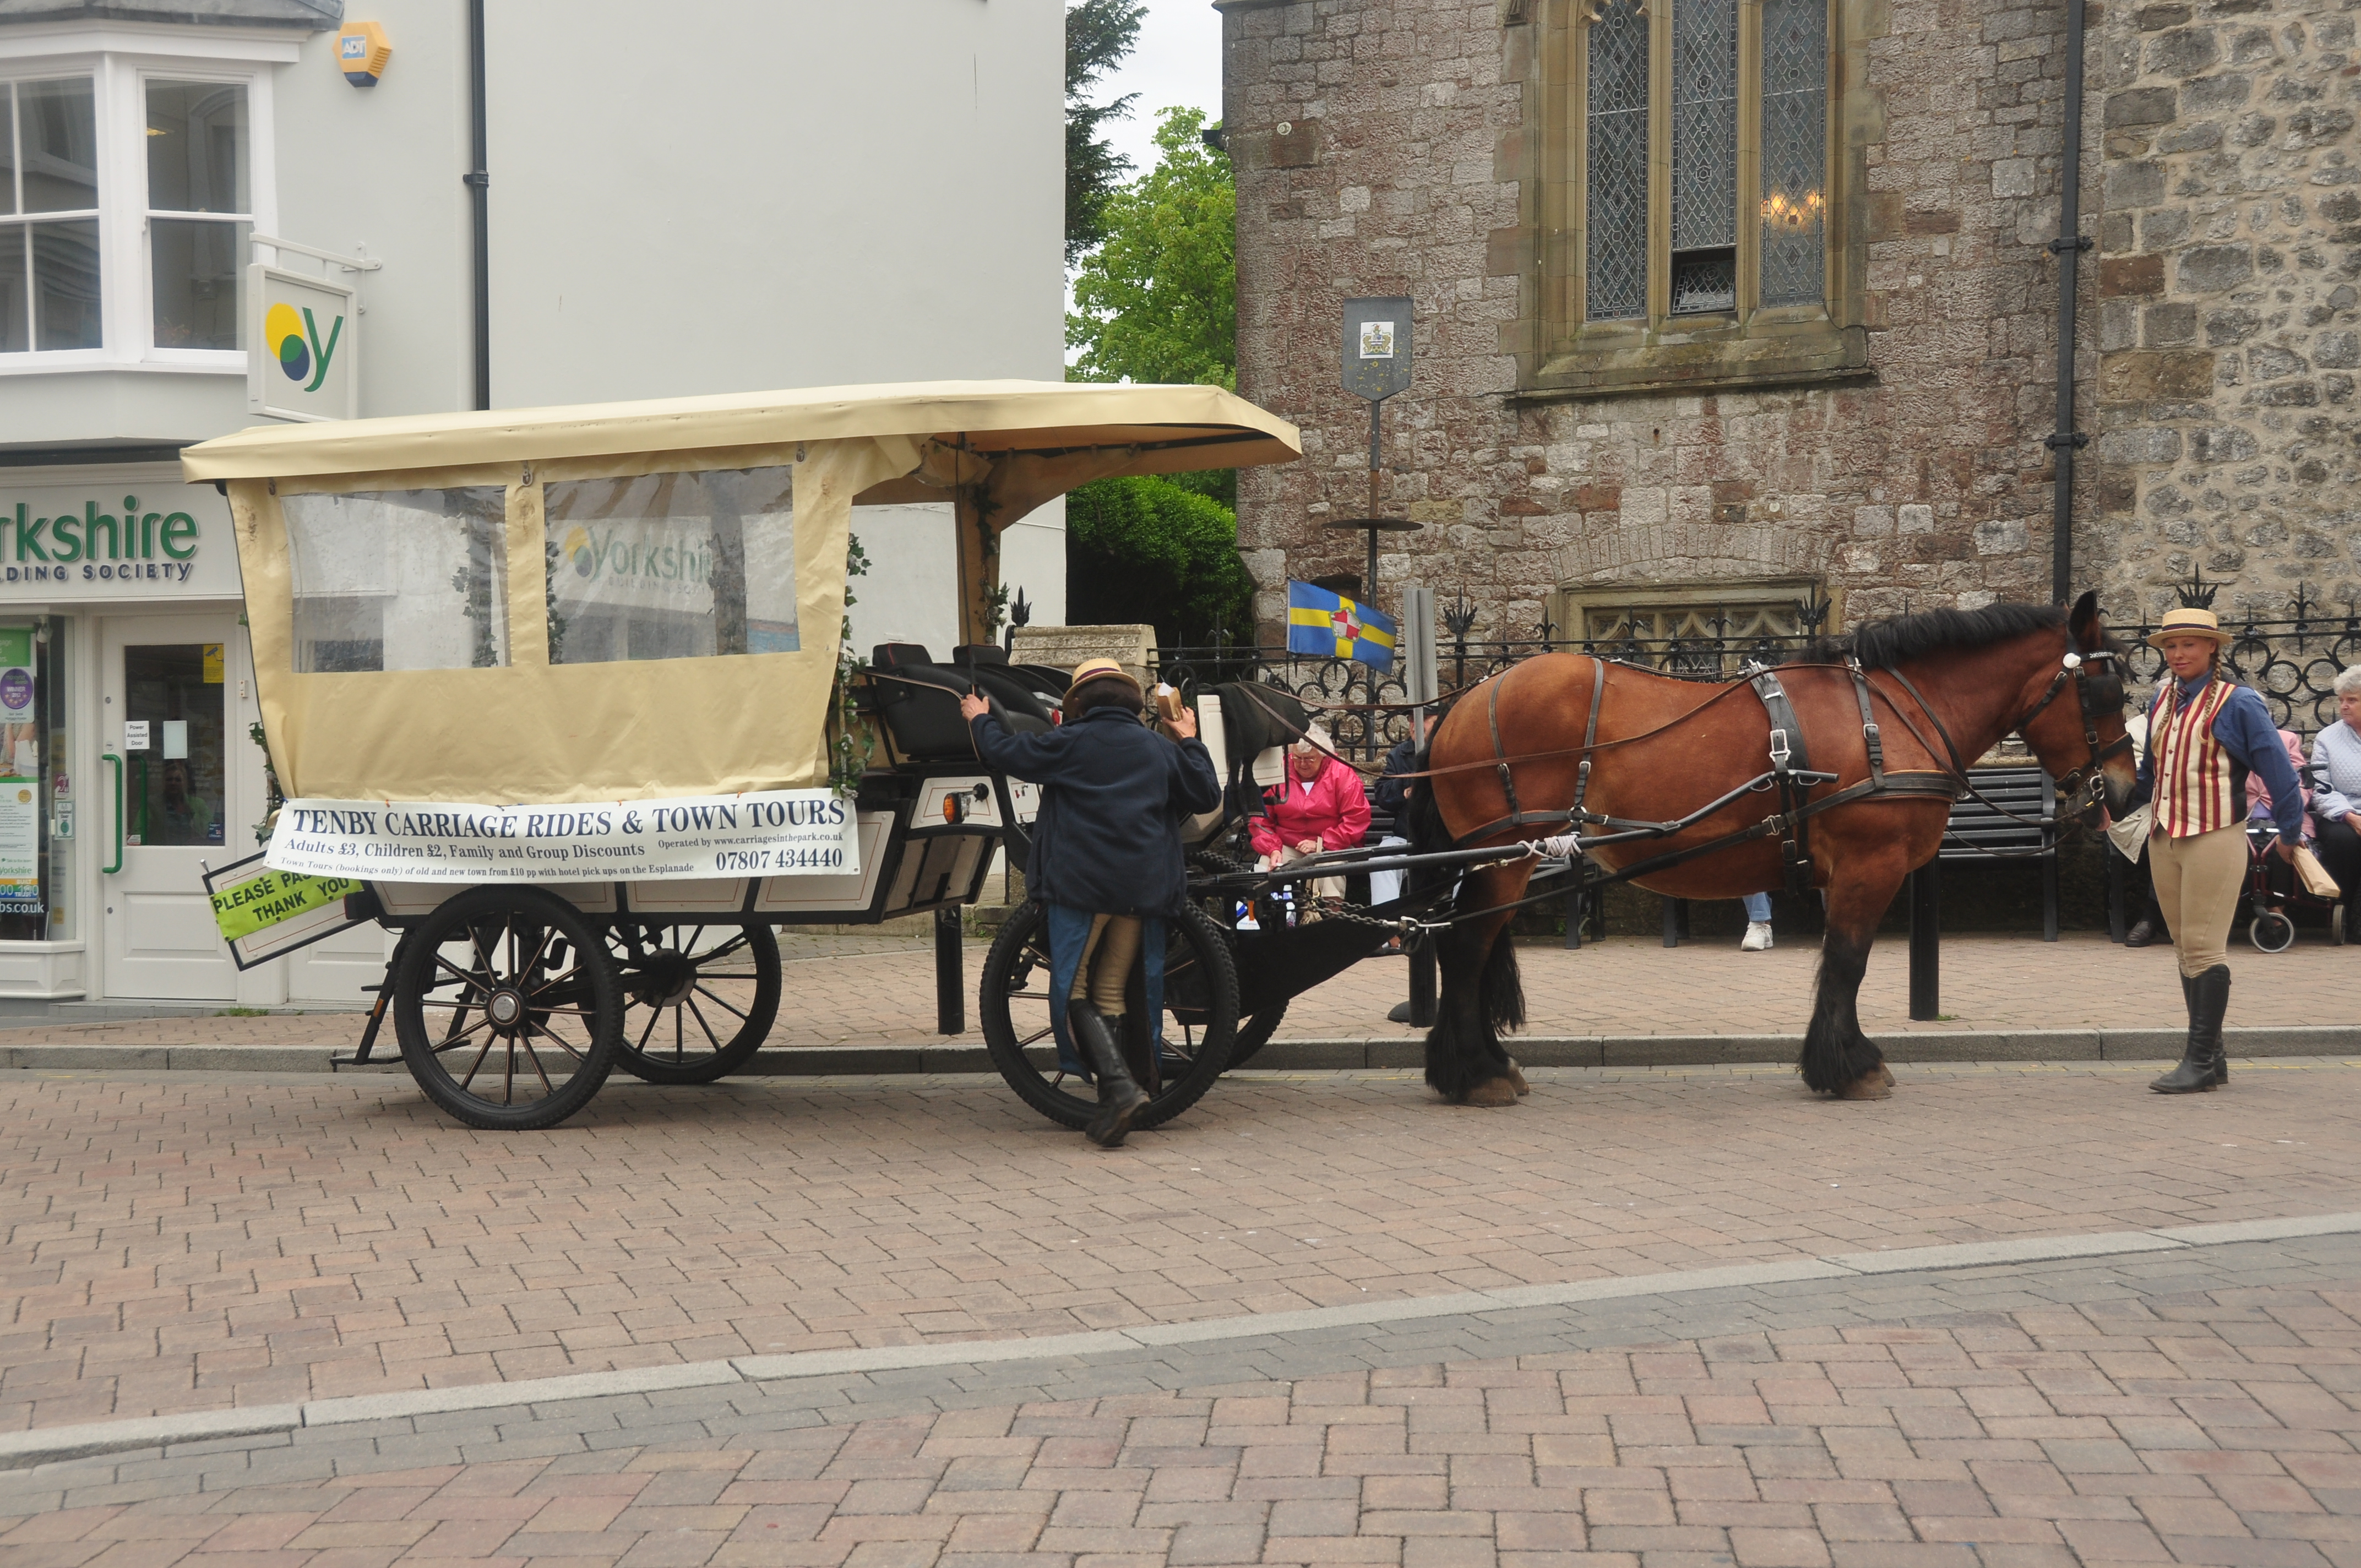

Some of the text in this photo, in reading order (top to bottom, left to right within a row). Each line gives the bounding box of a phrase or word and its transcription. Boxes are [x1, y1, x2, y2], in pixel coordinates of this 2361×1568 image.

[342, 41, 365, 53] ADT
[0, 562, 191, 581] DING SOCIETY
[293, 799, 845, 838] TENBY CARRIAGE RIDES & TOWN TOURS
[284, 838, 645, 863] Adults £3, Children £2, Family and Group Discounts
[658, 832, 844, 850] Operated by www.carriagesinthepark.co.uk
[281, 857, 304, 867] Town
[307, 861, 333, 870] Tours
[335, 863, 379, 875] (bookings
[381, 867, 403, 876] only)
[405, 867, 415, 875] of
[416, 867, 429, 875] old
[432, 867, 447, 876] and
[467, 868, 487, 876] town
[489, 867, 508, 876] from
[510, 867, 525, 876] £10
[526, 869, 536, 879] pp
[538, 867, 556, 876] with
[558, 867, 579, 875] hotel
[582, 866, 601, 876] pick
[602, 867, 618, 876] ups
[632, 864, 646, 874] the
[649, 863, 694, 875] Esplanade
[716, 848, 842, 871] 07807 434440
[213, 879, 275, 914] PLEASE
[252, 878, 350, 923] THANK YOU
